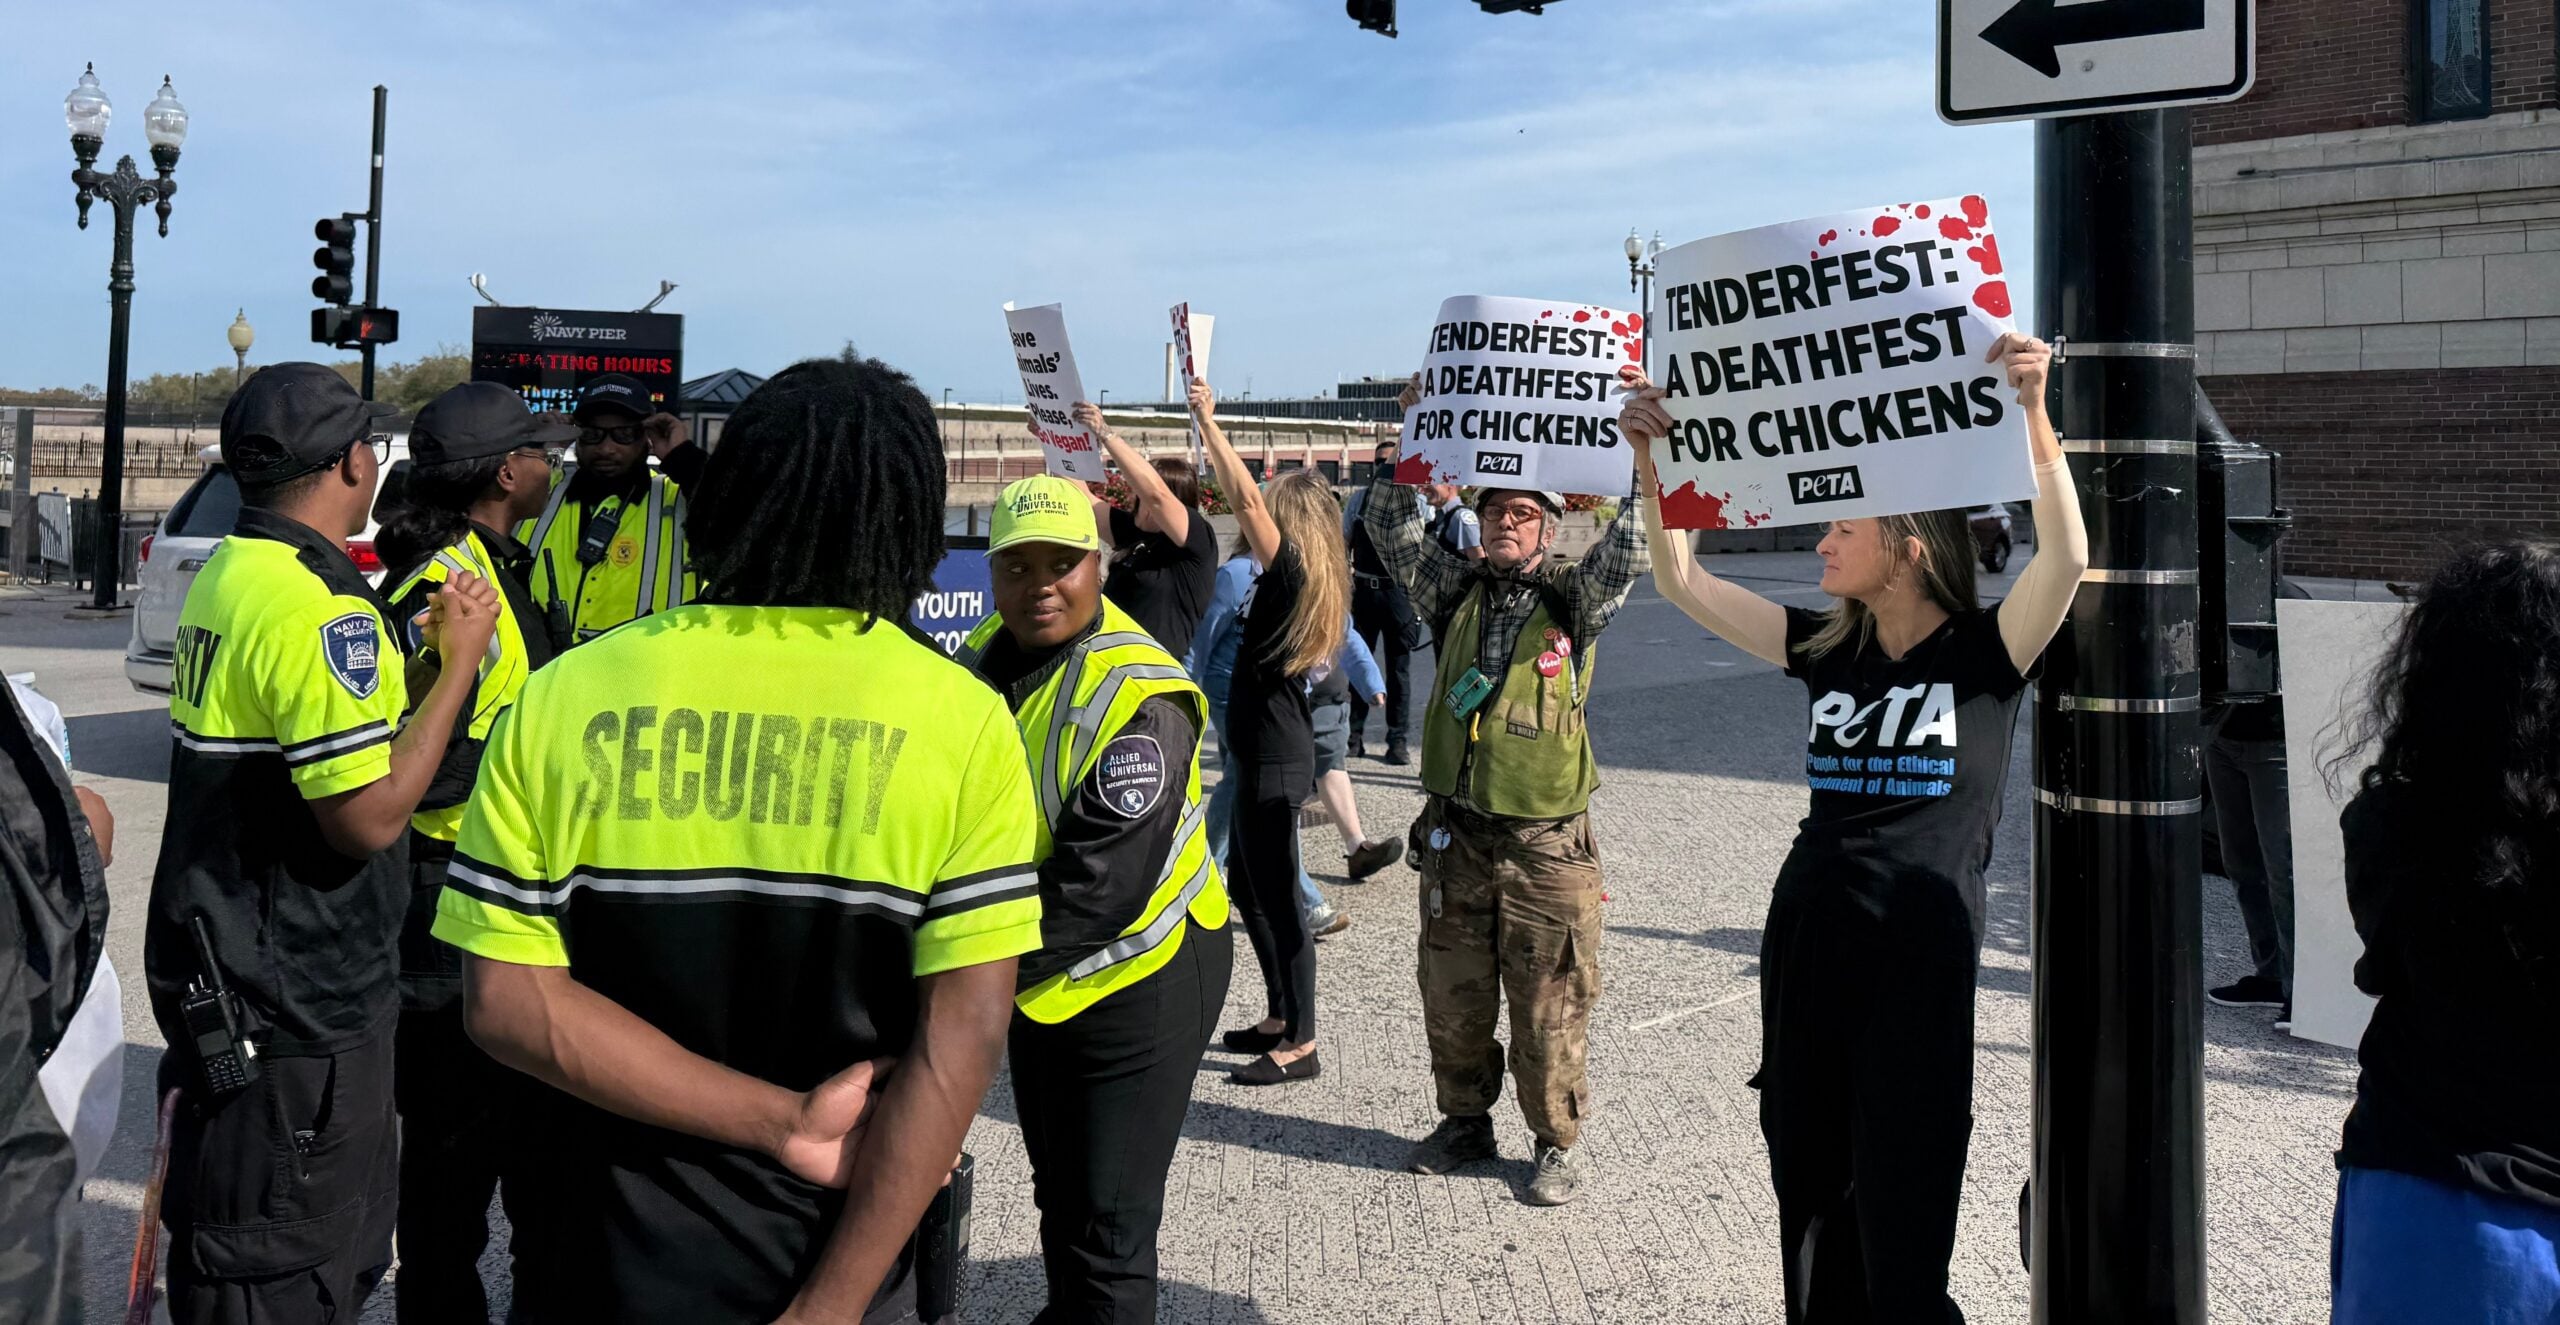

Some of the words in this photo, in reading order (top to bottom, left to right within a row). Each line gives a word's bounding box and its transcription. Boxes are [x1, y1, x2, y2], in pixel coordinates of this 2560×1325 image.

[1666, 239, 1960, 332] TENDERFEST:
[545, 326, 586, 339] NAVY
[588, 328, 627, 340] PIER
[1009, 327, 1037, 348] ave
[1429, 321, 1616, 360] TENDERFEST:
[1665, 353, 1690, 399] A
[1691, 306, 1968, 396] DEATHFEST
[604, 356, 673, 374] HOURS
[1023, 378, 1059, 400] Lives.
[1424, 367, 1435, 398] A
[1440, 365, 1614, 402] DEATHFEST
[1029, 402, 1074, 429] Please,
[1667, 416, 1743, 463] FOR
[1747, 376, 2004, 458] CHICKENS
[1413, 409, 1454, 441] FOR
[1460, 409, 1619, 449] CHICKENS
[1046, 429, 1093, 454] Vegan!
[1017, 501, 1068, 513] UNIVERSAL
[1019, 493, 1049, 503] ALLIED
[916, 590, 983, 620] YOUTH
[333, 620, 360, 635] NAVY
[362, 620, 377, 630] PIE
[343, 628, 373, 638] SECURITY
[1109, 752, 1140, 766] ALLIED
[1110, 762, 1158, 777] UNIVERSAL
[1807, 753, 1840, 773] People
[1842, 755, 1863, 772] for
[1867, 756, 1893, 772] the
[1897, 755, 1955, 776] Ethical
[576, 705, 907, 836] SECURITY
[1867, 777, 1884, 795] of
[1885, 777, 1953, 797] Animals
